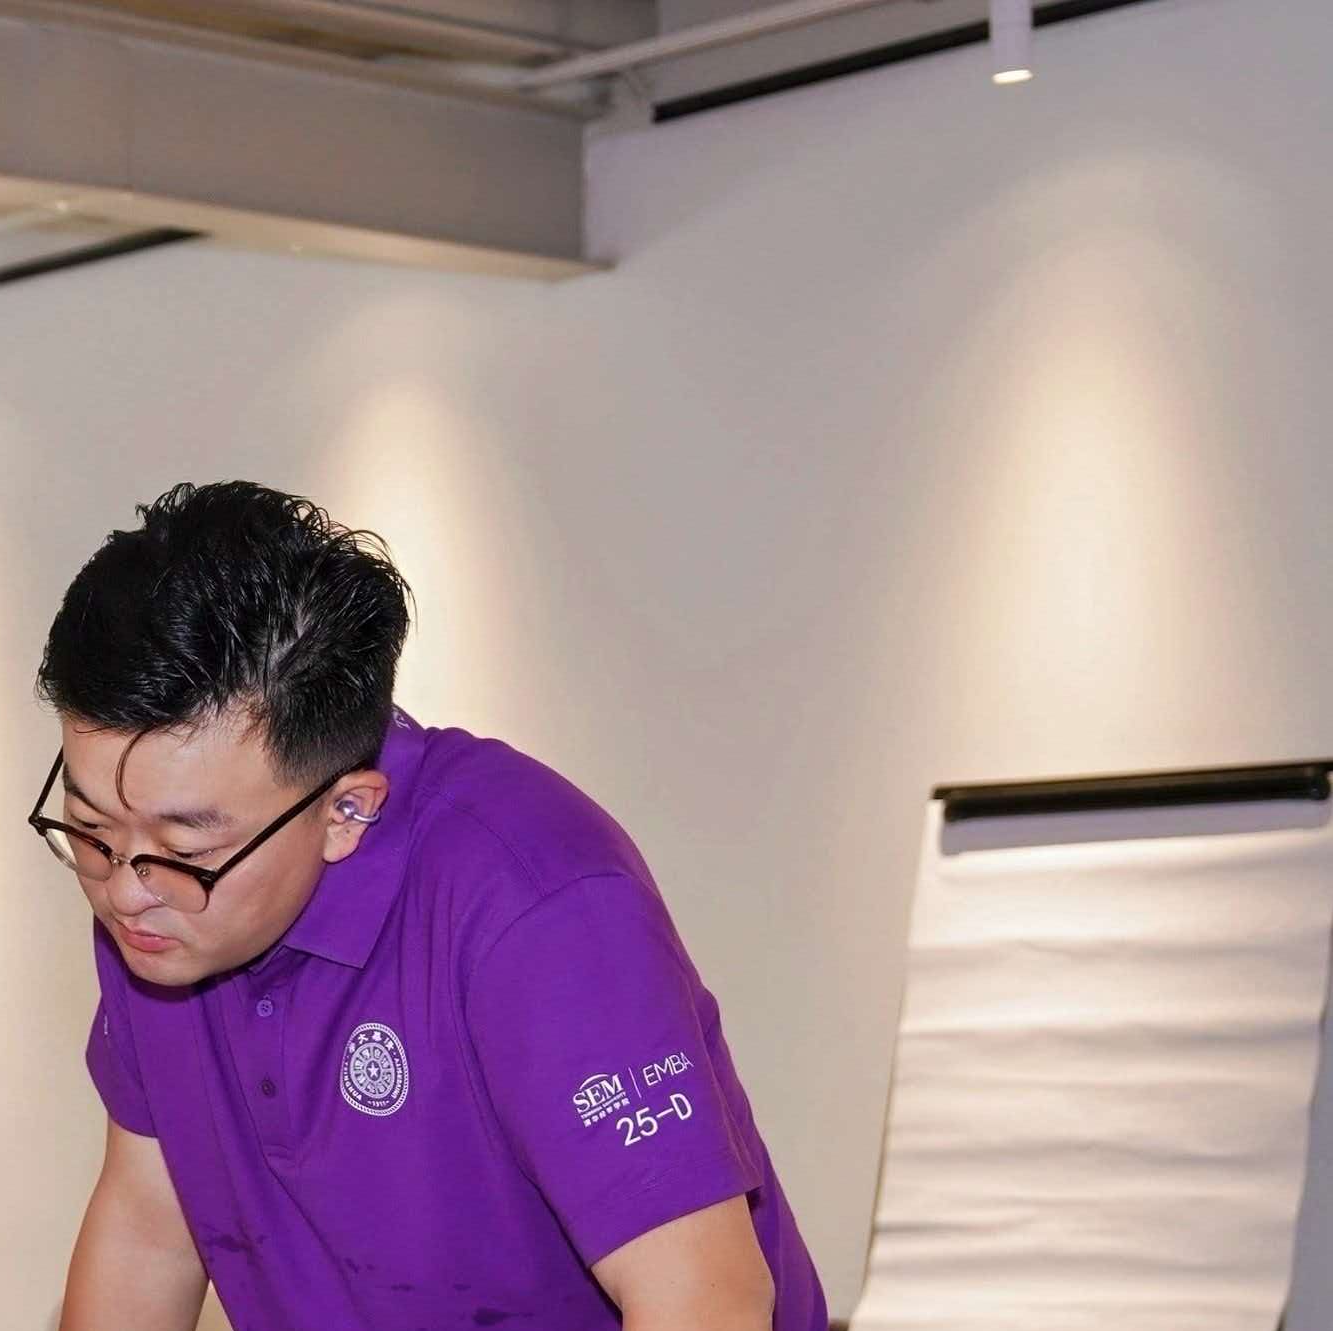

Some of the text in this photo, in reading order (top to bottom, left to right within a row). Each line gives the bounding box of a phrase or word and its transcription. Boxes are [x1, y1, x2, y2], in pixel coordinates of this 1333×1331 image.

[573, 1074, 625, 1114] SEM
[642, 1051, 695, 1087] EMBA
[616, 1092, 693, 1147] 25-D
